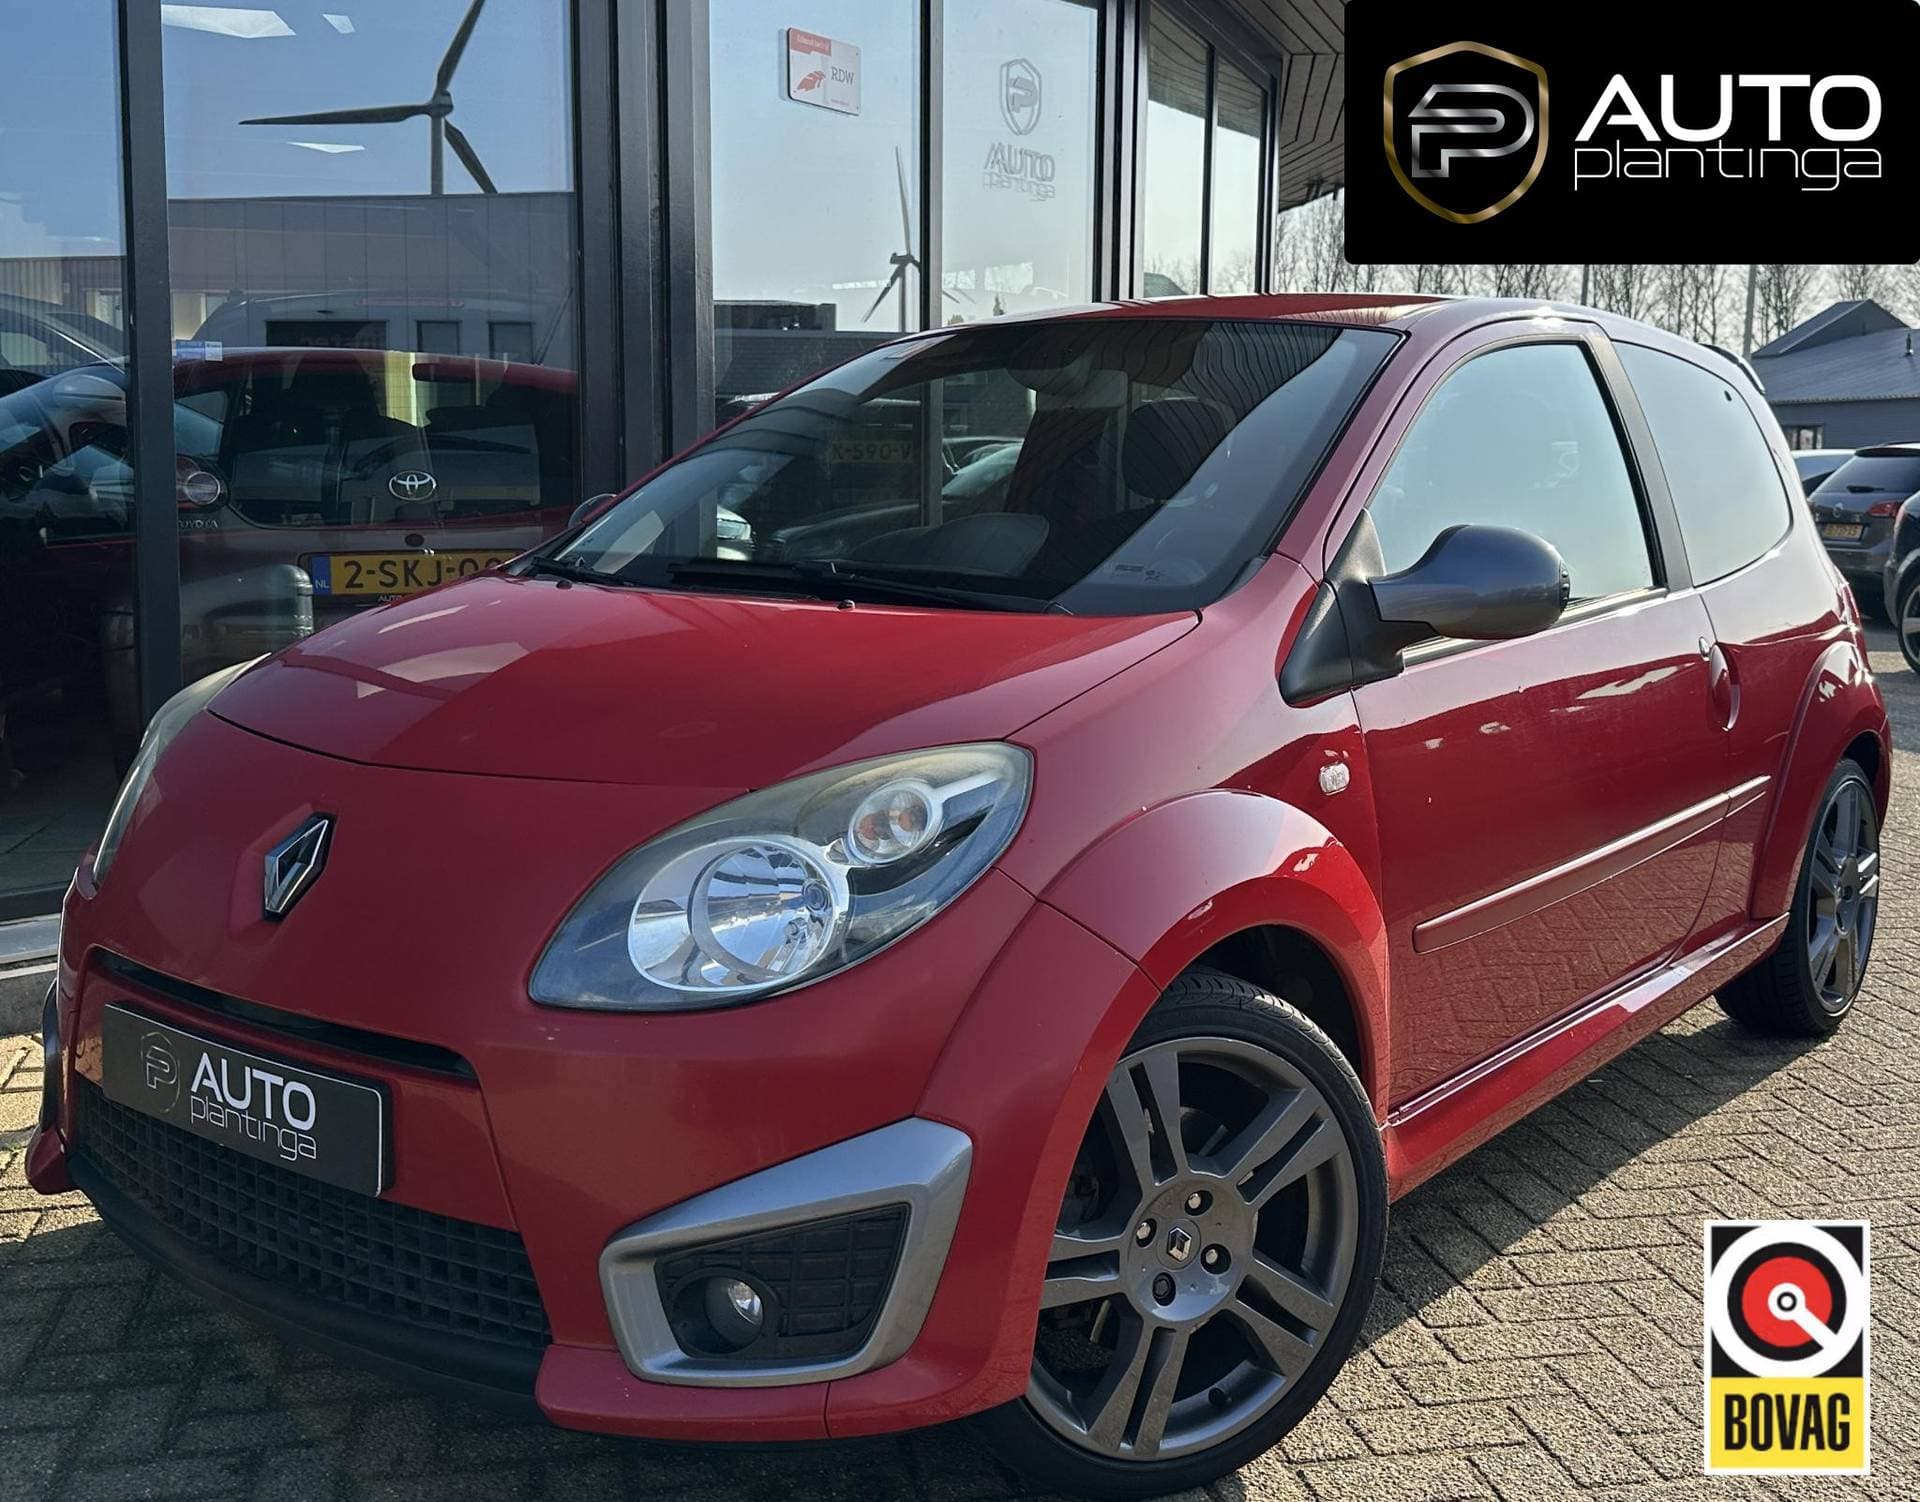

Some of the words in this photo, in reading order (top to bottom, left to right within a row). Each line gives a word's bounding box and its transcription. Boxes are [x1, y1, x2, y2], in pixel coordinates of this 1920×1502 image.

[831, 66, 855, 86] RDW
[984, 142, 1056, 182] AUTO
[315, 579, 329, 589] NL
[190, 1052, 316, 1131] AUTO
[190, 1095, 317, 1161] plantinga
